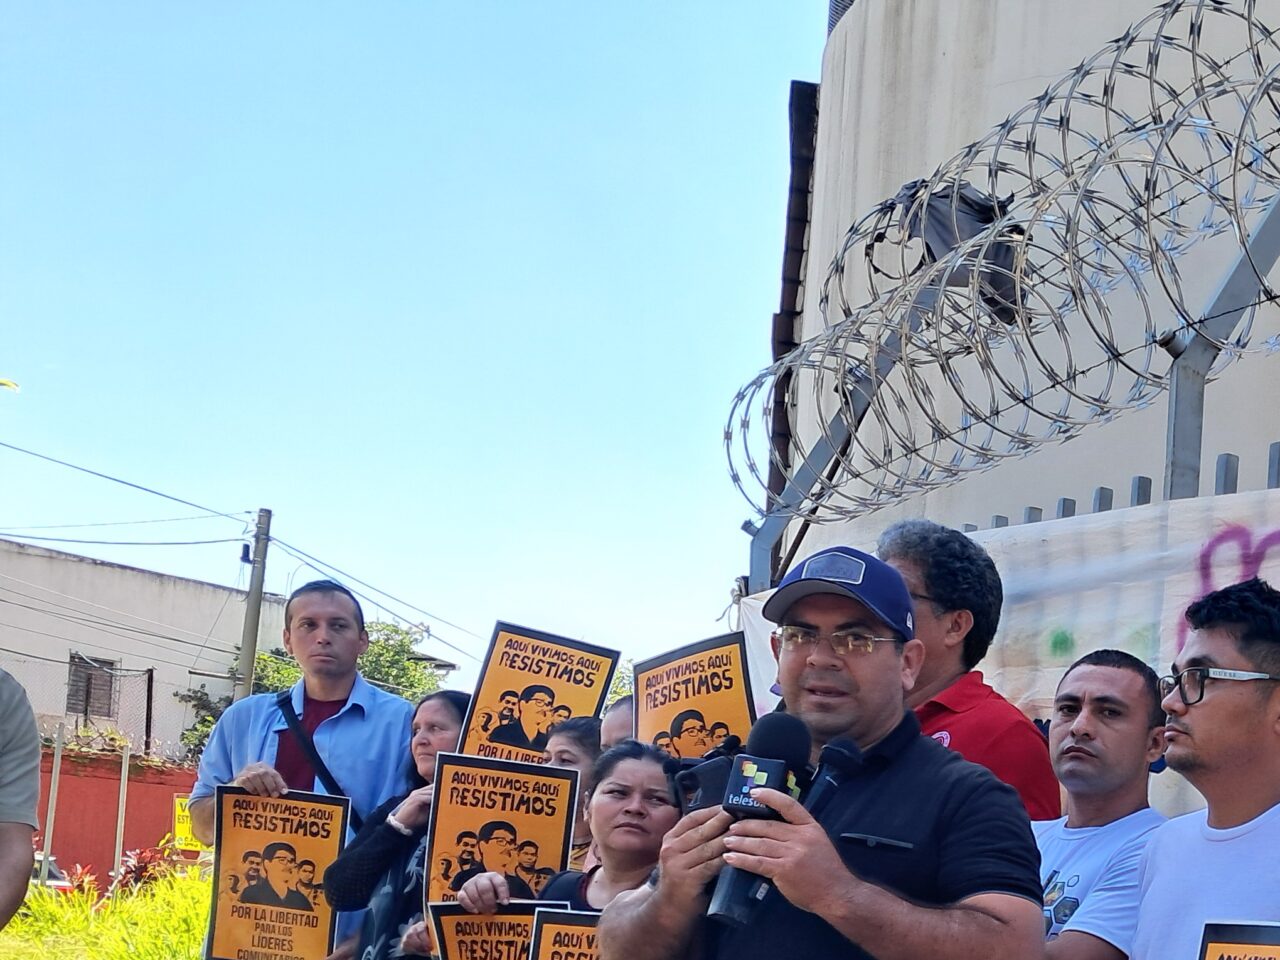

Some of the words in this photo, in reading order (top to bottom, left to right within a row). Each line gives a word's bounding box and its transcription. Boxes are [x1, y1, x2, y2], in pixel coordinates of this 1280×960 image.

[504, 638, 530, 652] AQUÍ
[531, 645, 575, 666] VIVIMOS,
[576, 656, 603, 672] AQUÍ
[499, 651, 596, 688] RESISTIMOS
[645, 670, 664, 691] AQUÍ
[665, 659, 707, 681] VIVIMOS,
[708, 651, 732, 669] AQUÍ
[646, 668, 733, 712] RESISTIMOS
[451, 771, 478, 786] AQUÍ
[480, 775, 531, 794] VIVIMOS,
[532, 781, 560, 797] AQUÍ
[233, 798, 259, 811] AQUÍ
[308, 808, 334, 822] AQUÍ
[449, 786, 557, 817] RESISTIMOS
[233, 812, 331, 839] RESISTIMOS
[231, 905, 251, 919] POR
[254, 908, 266, 921] LA
[270, 910, 319, 929] LIBERTAD
[255, 922, 276, 934] PARA
[278, 926, 293, 937] LOS
[455, 921, 482, 937] AQUÍ
[552, 931, 585, 949] AQUÍ
